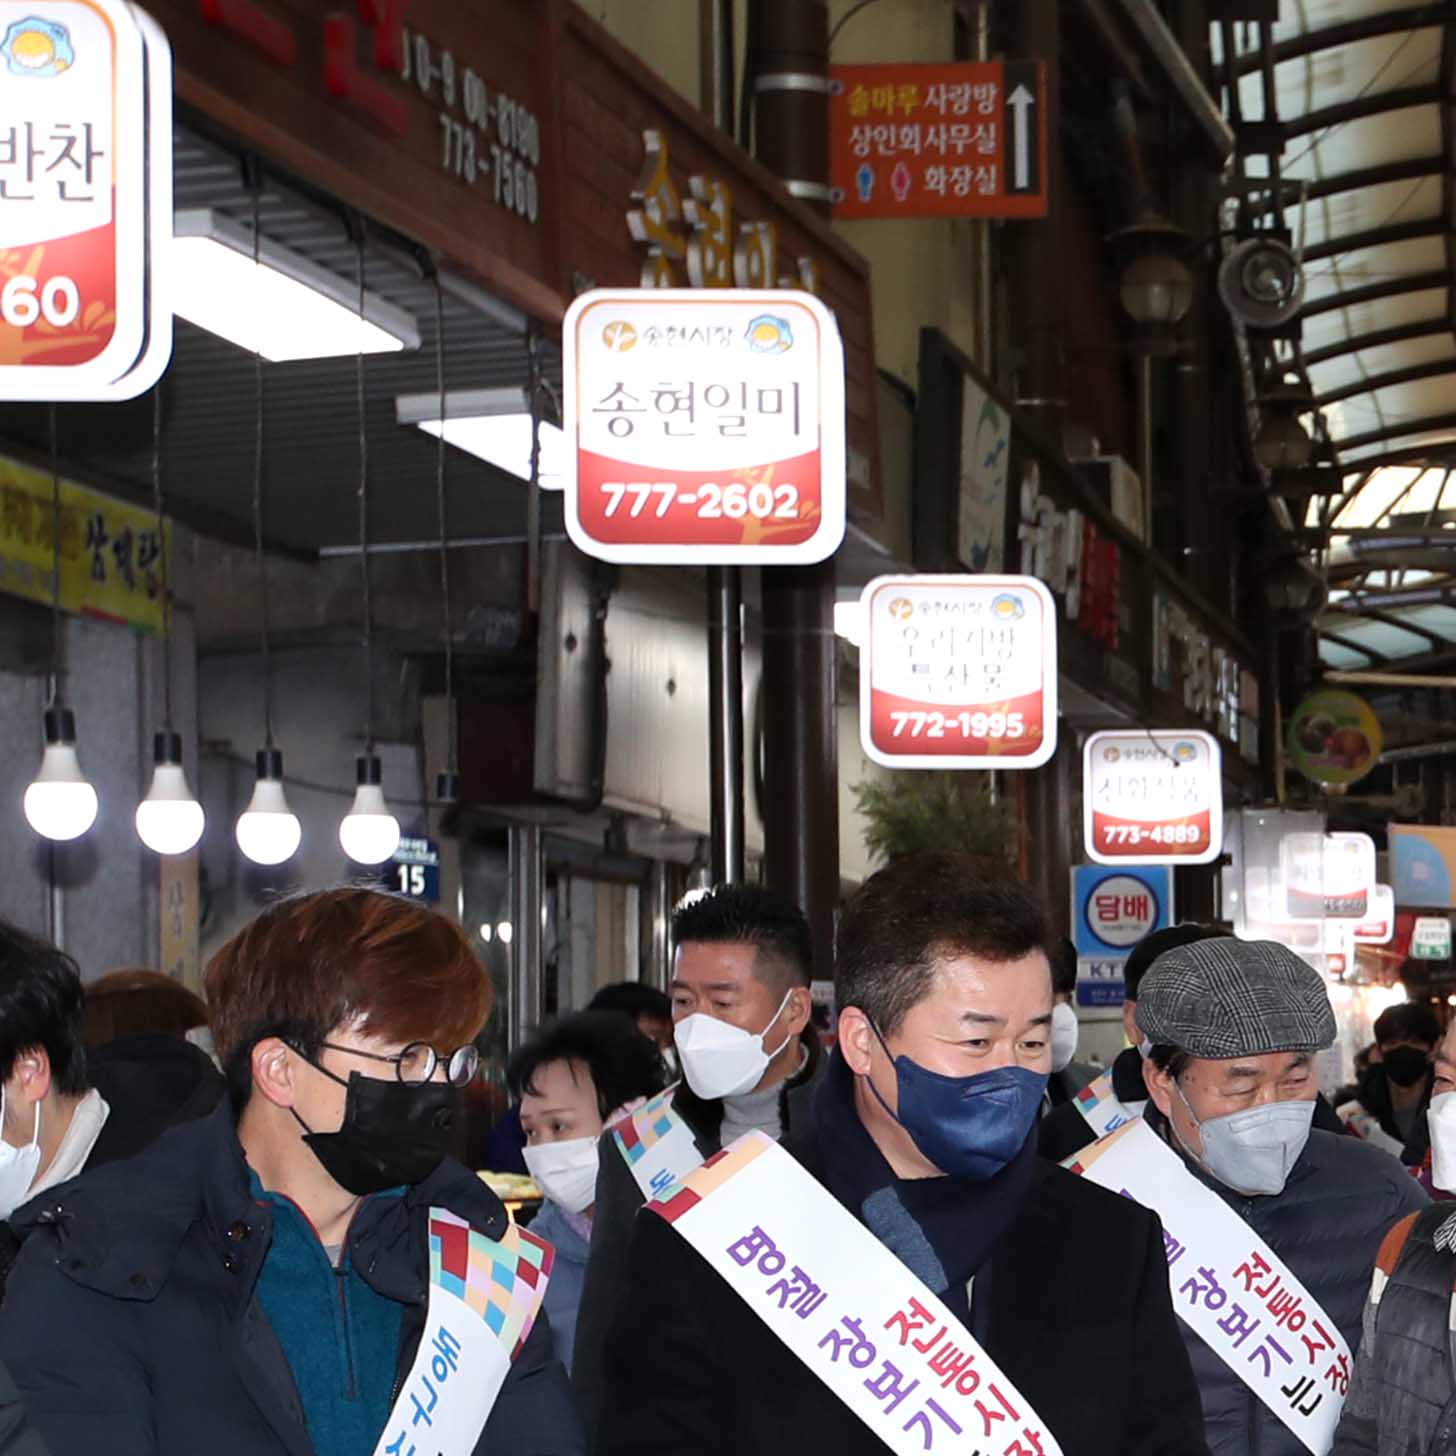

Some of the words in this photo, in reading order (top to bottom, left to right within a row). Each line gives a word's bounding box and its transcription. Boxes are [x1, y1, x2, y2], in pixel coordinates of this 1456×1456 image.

[924, 83, 997, 115] 사랑방
[0, 122, 104, 203] 반찬
[924, 164, 997, 197] 화장실
[642, 325, 735, 347] 송현시장
[592, 382, 801, 438] 송현일미
[600, 483, 798, 518] 777-2602
[889, 711, 1025, 738] 772-1995
[398, 863, 425, 896] 15
[1095, 894, 1148, 923] 담배
[726, 1225, 828, 1319] 명절
[1179, 1266, 1323, 1417] 장보기는
